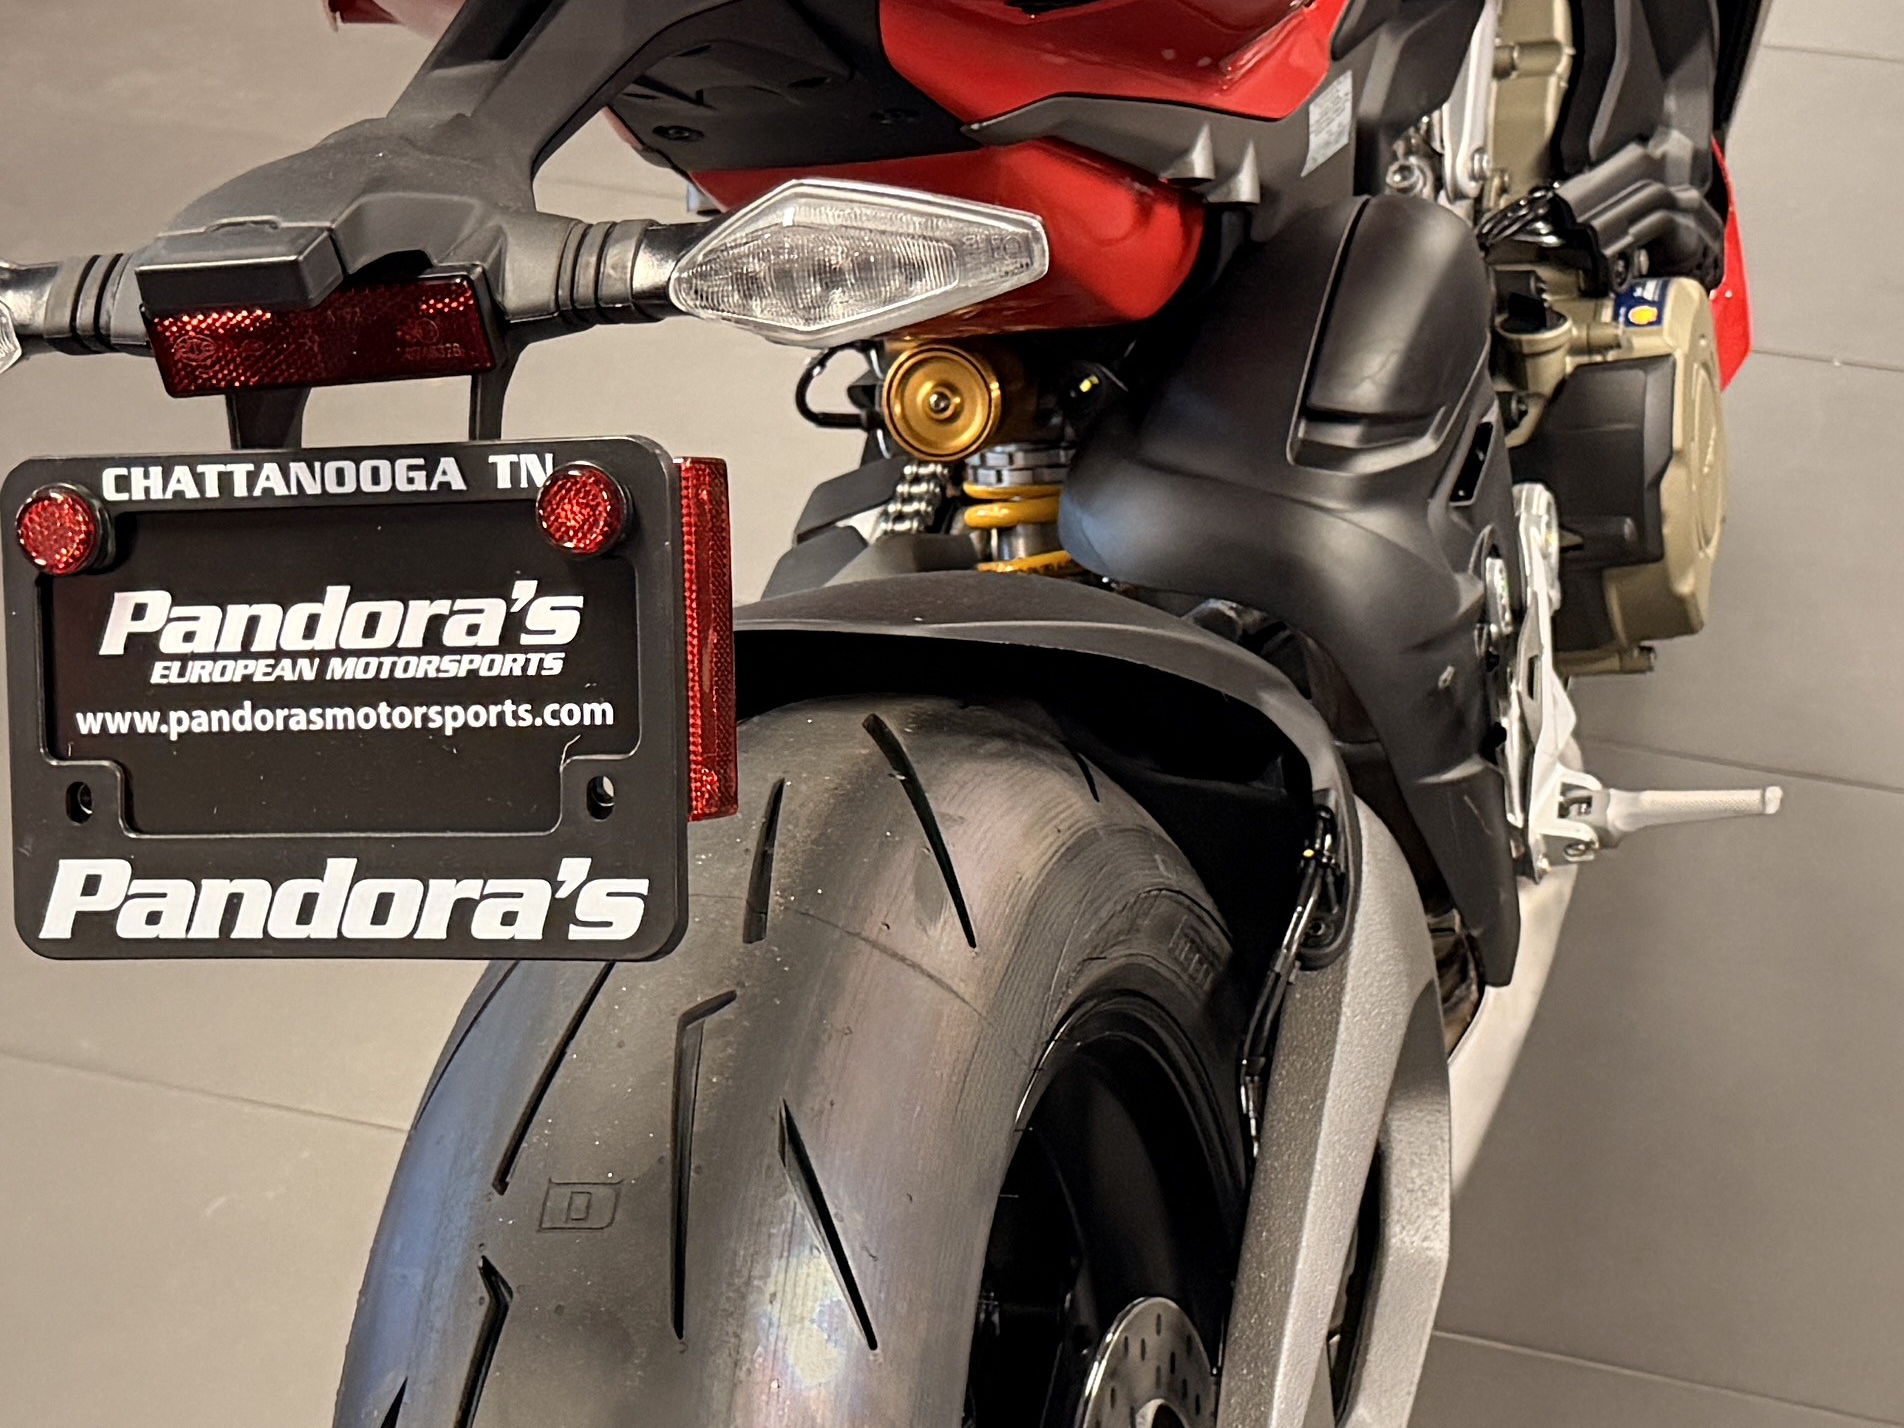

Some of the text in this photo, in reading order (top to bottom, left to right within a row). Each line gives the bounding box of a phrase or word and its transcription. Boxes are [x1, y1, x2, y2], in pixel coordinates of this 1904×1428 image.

[101, 453, 554, 502] CHATTANOOGA TN
[99, 580, 584, 656] Pandora's
[150, 653, 566, 685] EUROPEAN MOTORSPORTS
[76, 699, 614, 741] www.pandorasmotorsports.com
[38, 857, 650, 941] Pandora's
